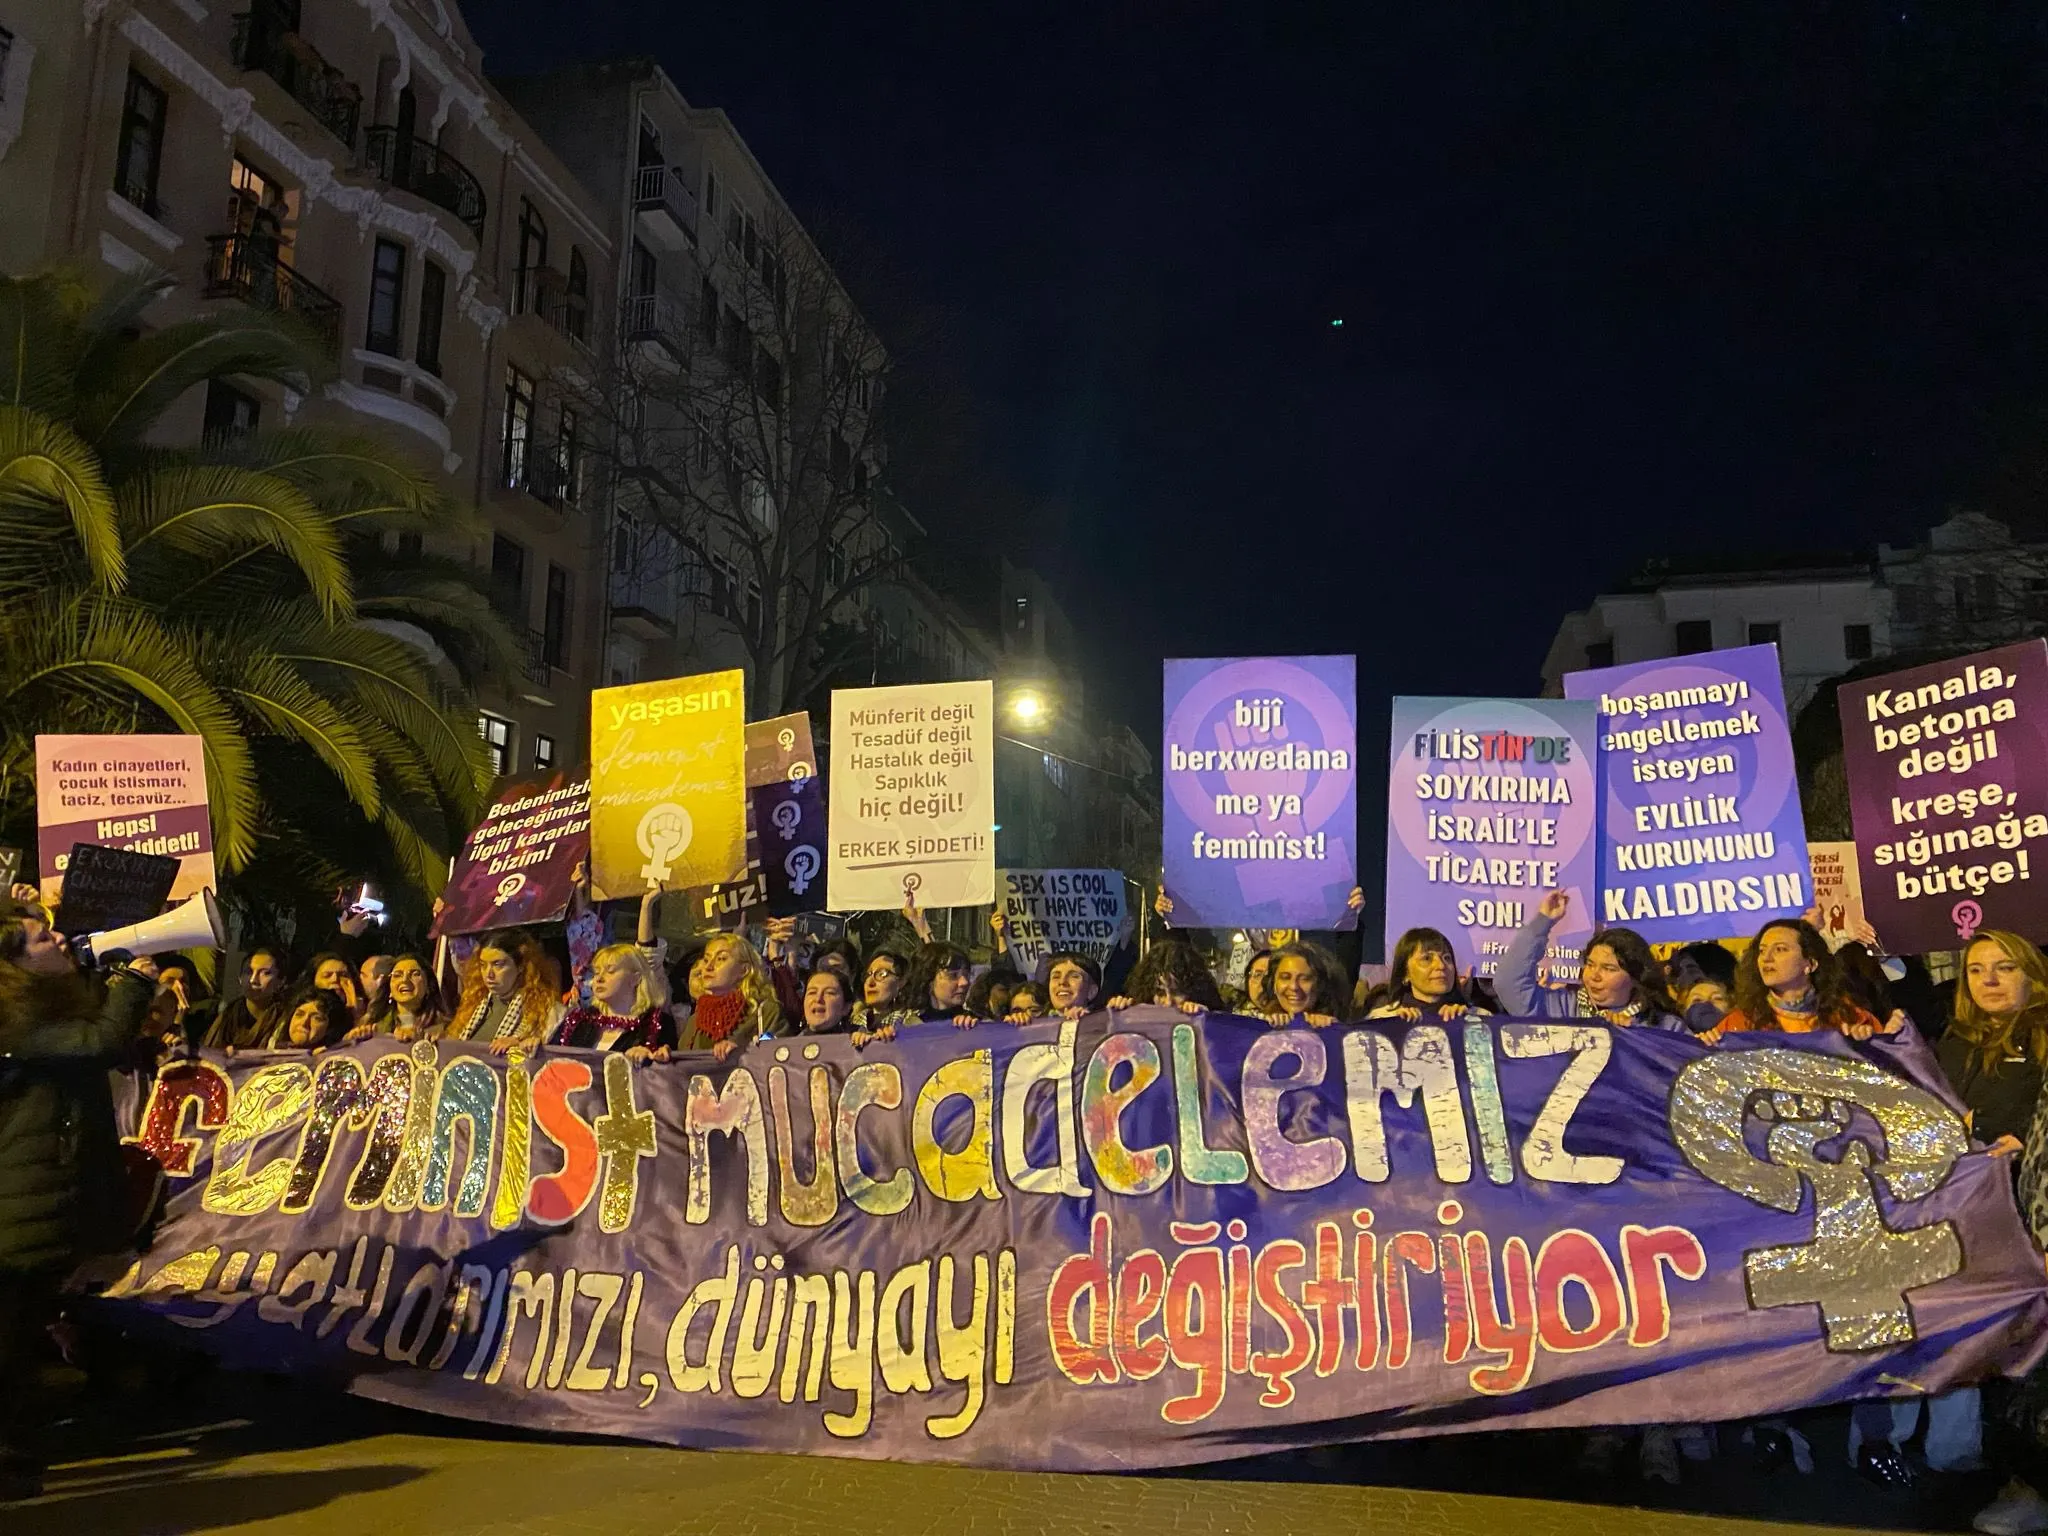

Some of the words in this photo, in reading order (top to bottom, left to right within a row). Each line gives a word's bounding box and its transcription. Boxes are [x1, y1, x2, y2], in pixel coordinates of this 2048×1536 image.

[1601, 681, 1749, 719] boşanmayı
[1866, 663, 2017, 724] Kanala,
[608, 688, 731, 731] yaşasın
[850, 708, 925, 726] Münferit
[930, 704, 975, 724] değil
[1235, 698, 1285, 732] bijî
[852, 729, 923, 748] Tesadüf
[928, 726, 972, 746] değil
[1600, 709, 1760, 754] engellemek
[1874, 697, 2017, 754] betona
[52, 760, 98, 773] Kadın
[103, 760, 191, 776] cinayetleri,
[850, 750, 923, 770] Hastalık
[929, 748, 973, 768] değil
[1170, 744, 1349, 772] berxwedana
[1632, 753, 1734, 783] isteyen
[1898, 730, 1998, 780] değil
[59, 777, 108, 790] çocuk
[113, 775, 187, 789] istismarı,
[875, 772, 947, 793] Sapıklık
[1415, 774, 1571, 804] SOYKIRIMA
[61, 793, 105, 807] taciz,
[111, 791, 187, 806] tecavüz...
[859, 798, 892, 822] hiç
[899, 792, 964, 820] değil!
[1216, 794, 1258, 816] me
[1268, 793, 1302, 820] ya
[1635, 794, 1739, 833] EVLİLİK
[1891, 782, 2018, 826] kreşe,
[97, 815, 157, 840] Hepsi
[1874, 811, 2048, 868] sığınağa
[469, 836, 512, 862] ilgili
[488, 843, 556, 876] bizim!
[838, 841, 900, 859] ERKEK
[905, 832, 985, 859] ŞİDDETİ!
[1192, 832, 1326, 861] femînîst!
[1616, 832, 1776, 872] KURUMUNU
[1006, 874, 1045, 895] SEX
[1051, 876, 1069, 895] IS
[1072, 874, 1114, 895] COOL
[1425, 853, 1558, 888] TİCARETE
[1896, 849, 2031, 901] bütçe!
[1007, 898, 1039, 916] BUT
[1044, 897, 1087, 917] HAVE
[1091, 898, 1118, 917] YOU
[1604, 872, 1804, 922] KALDIRSIN
[1457, 899, 1524, 928] SON!
[1009, 920, 1051, 939] EVER
[1057, 920, 1114, 938] FUCKED
[1013, 941, 1045, 961] THE
[1047, 1199, 1707, 1424] değiştiriyor
